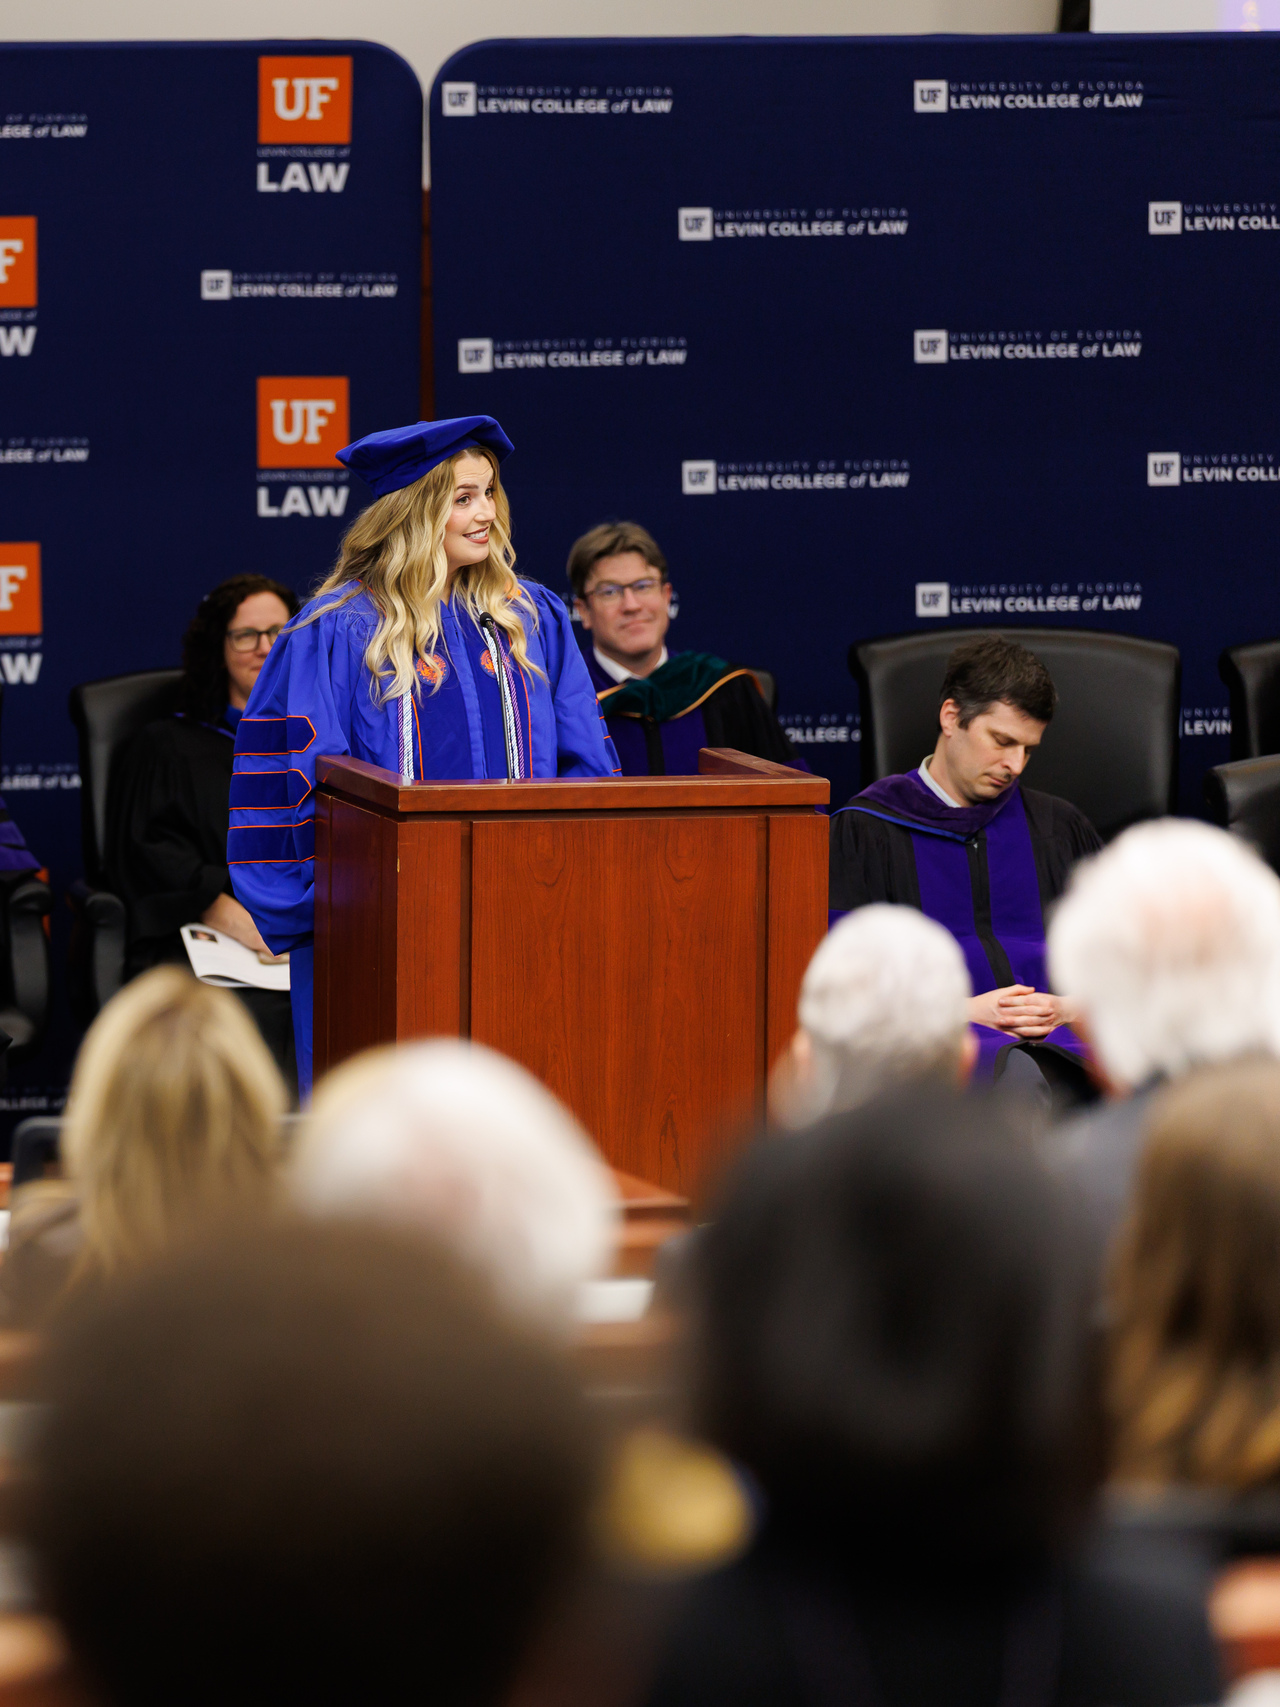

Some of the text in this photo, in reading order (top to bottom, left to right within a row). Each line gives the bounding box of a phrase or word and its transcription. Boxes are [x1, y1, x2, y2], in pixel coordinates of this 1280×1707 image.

[949, 81, 1143, 92] UNIVERSITY OF FLORIDA
[273, 78, 337, 119] UF
[477, 99, 673, 114] LEVIN COLLEGE of LAW
[949, 94, 1143, 110] LEVIN COLLEGE of LAW
[257, 162, 349, 193] LAW
[1184, 203, 1277, 214] UNIVERSITY
[714, 221, 908, 238] LEVIN COLLEGE of LAW
[1184, 216, 1280, 231] LEVIN COLL
[949, 343, 1142, 360] LEVIN COLLEGE of LAW
[494, 353, 547, 369] LEVIN
[547, 351, 625, 367] COLLEGE
[646, 351, 687, 365] LAW
[271, 400, 336, 444] UF
[1182, 454, 1274, 465] UNIVERSITY
[717, 476, 770, 491] LEVIN
[770, 474, 848, 490] COLLEGE
[869, 473, 910, 488] LAW
[1182, 467, 1280, 483] LEVIN COLL
[257, 486, 349, 517] LAW
[951, 596, 1142, 614] LEVIN COLLEGE of LAW
[1183, 707, 1230, 718] UNIVE
[785, 727, 849, 743] OLLEGE
[1184, 720, 1232, 735] LEVIN
[61, 774, 81, 789] LA
